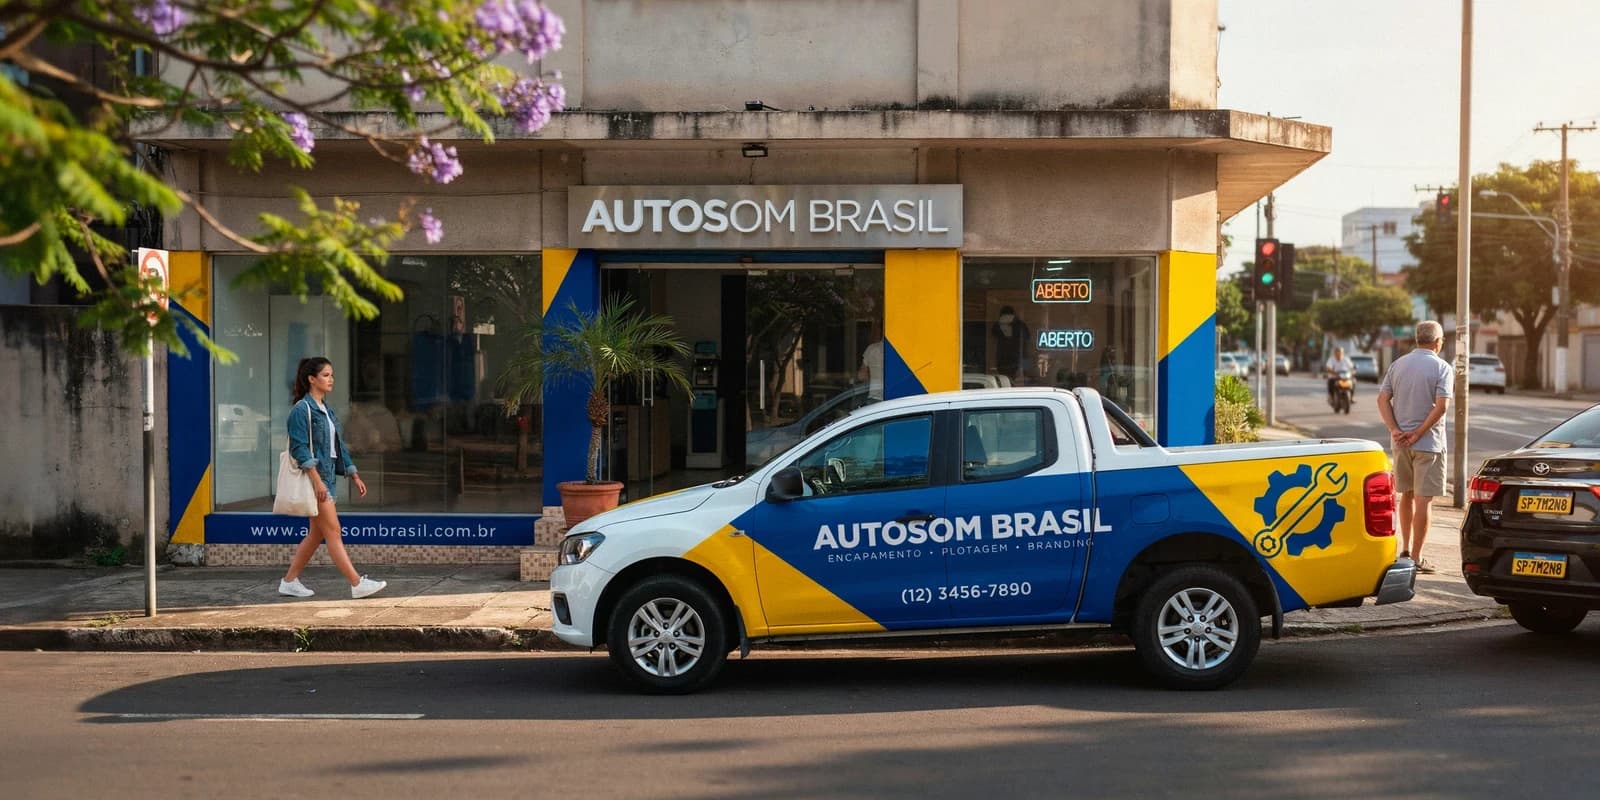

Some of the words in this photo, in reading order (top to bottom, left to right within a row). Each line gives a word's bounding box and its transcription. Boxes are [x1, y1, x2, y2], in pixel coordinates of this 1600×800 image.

[581, 198, 796, 234] AUTOSOM
[808, 199, 949, 234] BRASIL
[1035, 283, 1089, 299] ABERTO
[1038, 331, 1092, 348] ABERTO
[250, 523, 497, 538] www.asombrasil.com.br
[813, 515, 982, 550] AUTOSOM
[991, 507, 1113, 539] BRASIL
[828, 549, 921, 563] ENCAPAMENTO
[942, 544, 1008, 556] PLOTAGEM
[901, 587, 932, 604] (12)
[938, 581, 1032, 601] 3456-7890
